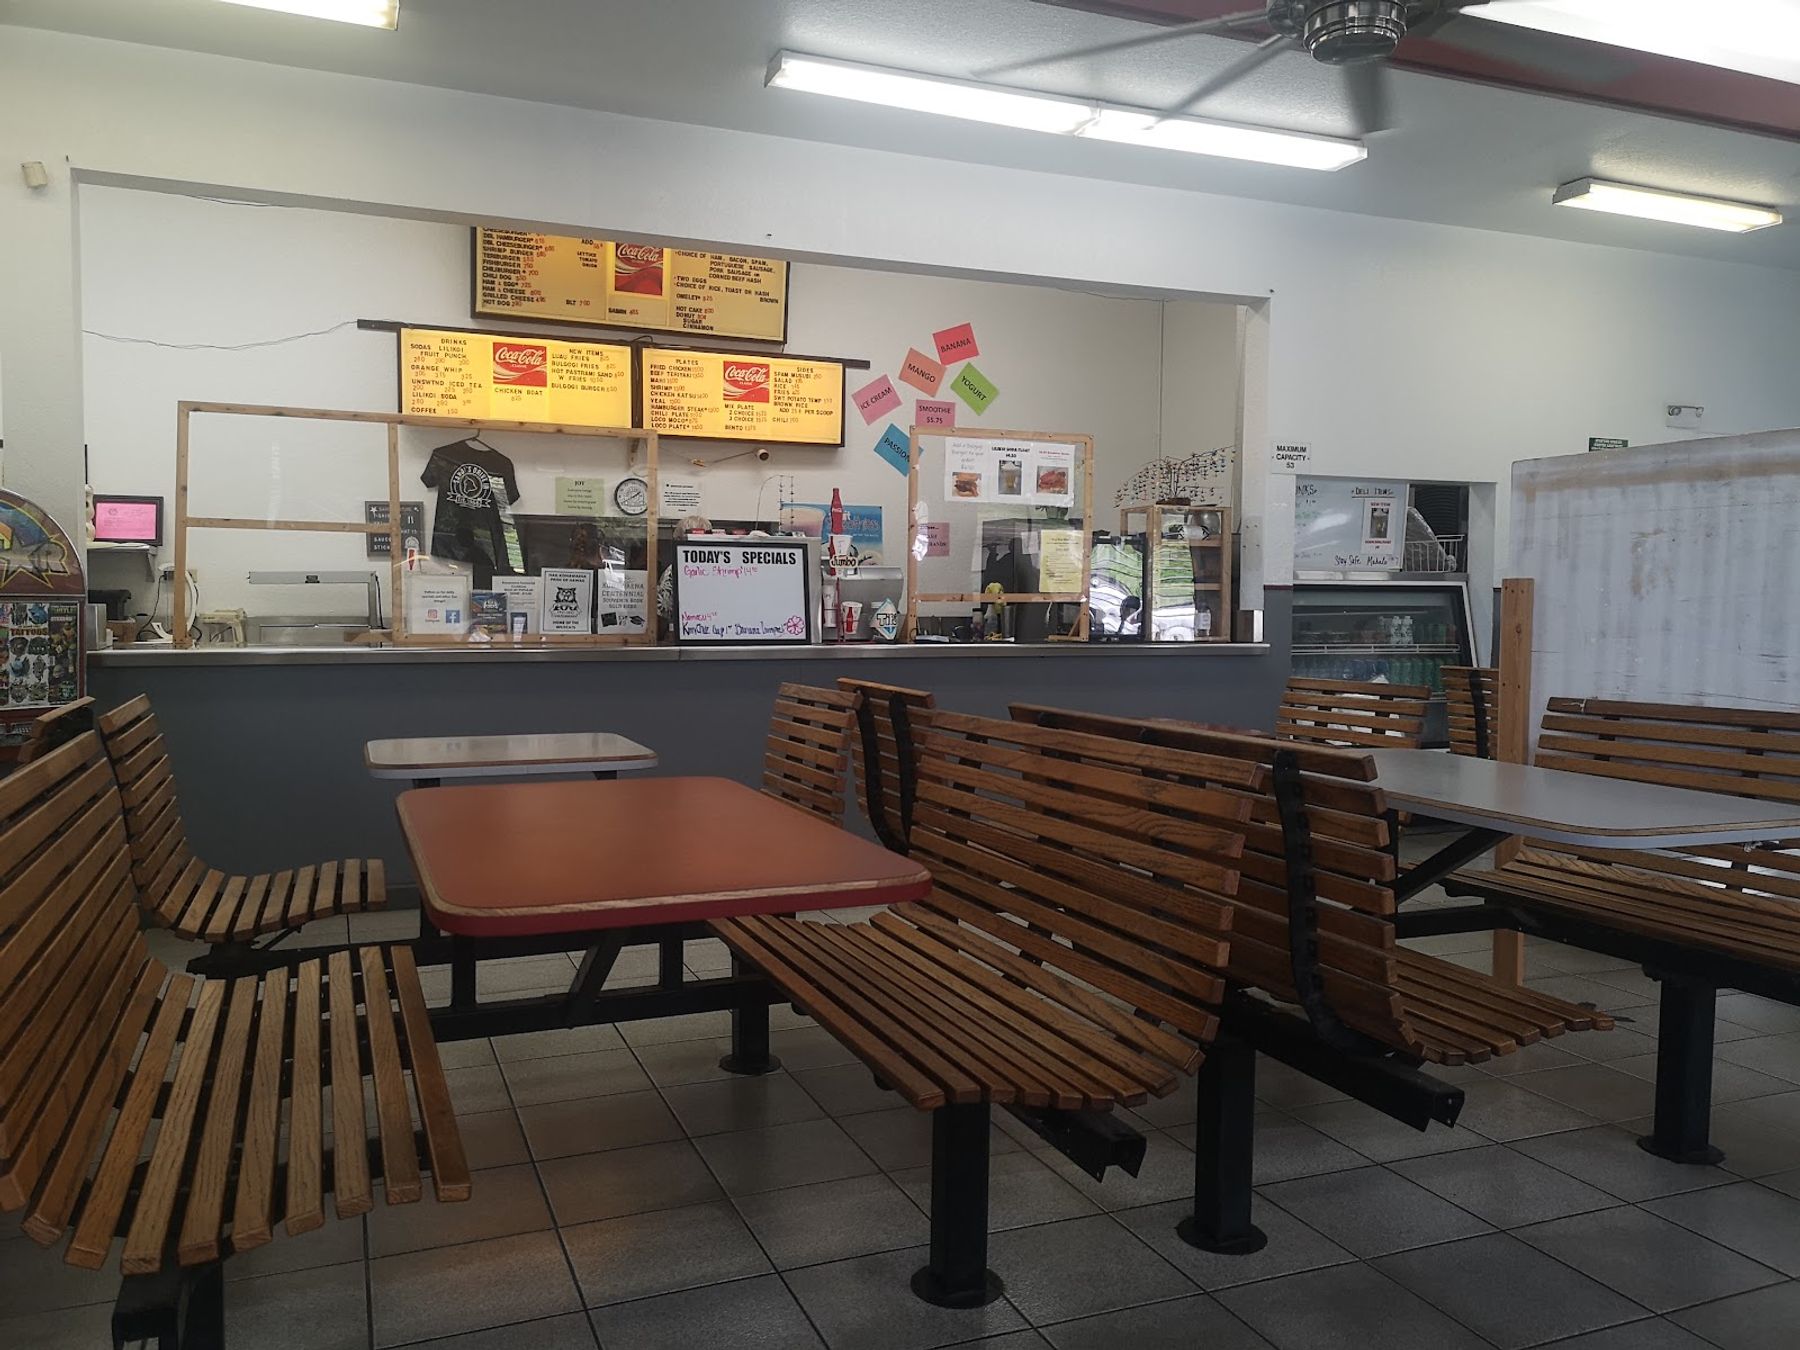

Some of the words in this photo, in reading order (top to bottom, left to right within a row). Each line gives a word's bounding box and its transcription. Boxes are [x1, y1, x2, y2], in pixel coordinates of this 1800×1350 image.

[618, 243, 662, 262] Coca-Cola
[940, 338, 971, 352] BANANA
[496, 347, 544, 366] Coca-Cola
[725, 365, 768, 383] Coca-Cola
[908, 363, 936, 383] MANGO
[962, 375, 986, 400] YOGURT
[860, 398, 871, 410] ICE
[870, 387, 892, 404] CREAM
[918, 405, 951, 414] SMOOTHIE
[683, 550, 731, 564] TODAY'S
[742, 551, 796, 564] SPECIALS
[832, 556, 857, 567] Jumbo
